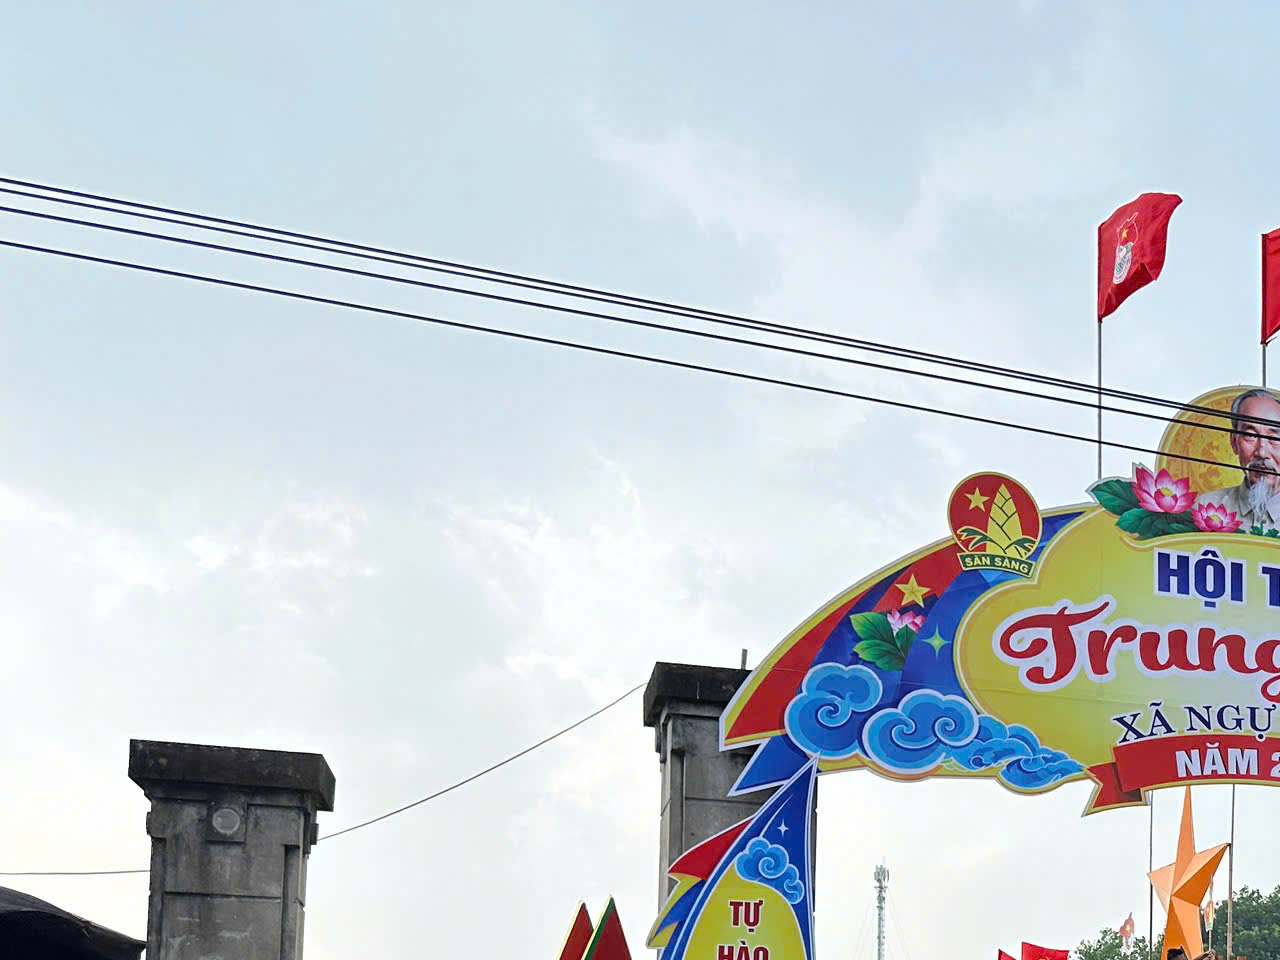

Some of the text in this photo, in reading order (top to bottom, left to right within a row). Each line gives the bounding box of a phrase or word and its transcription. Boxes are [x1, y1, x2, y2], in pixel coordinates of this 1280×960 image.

[1157, 549, 1244, 609] HỘI
[1113, 701, 1176, 744] XÃ
[1183, 704, 1277, 741] NGỰ
[1175, 742, 1259, 778] NĂM
[729, 899, 764, 933] TỰ
